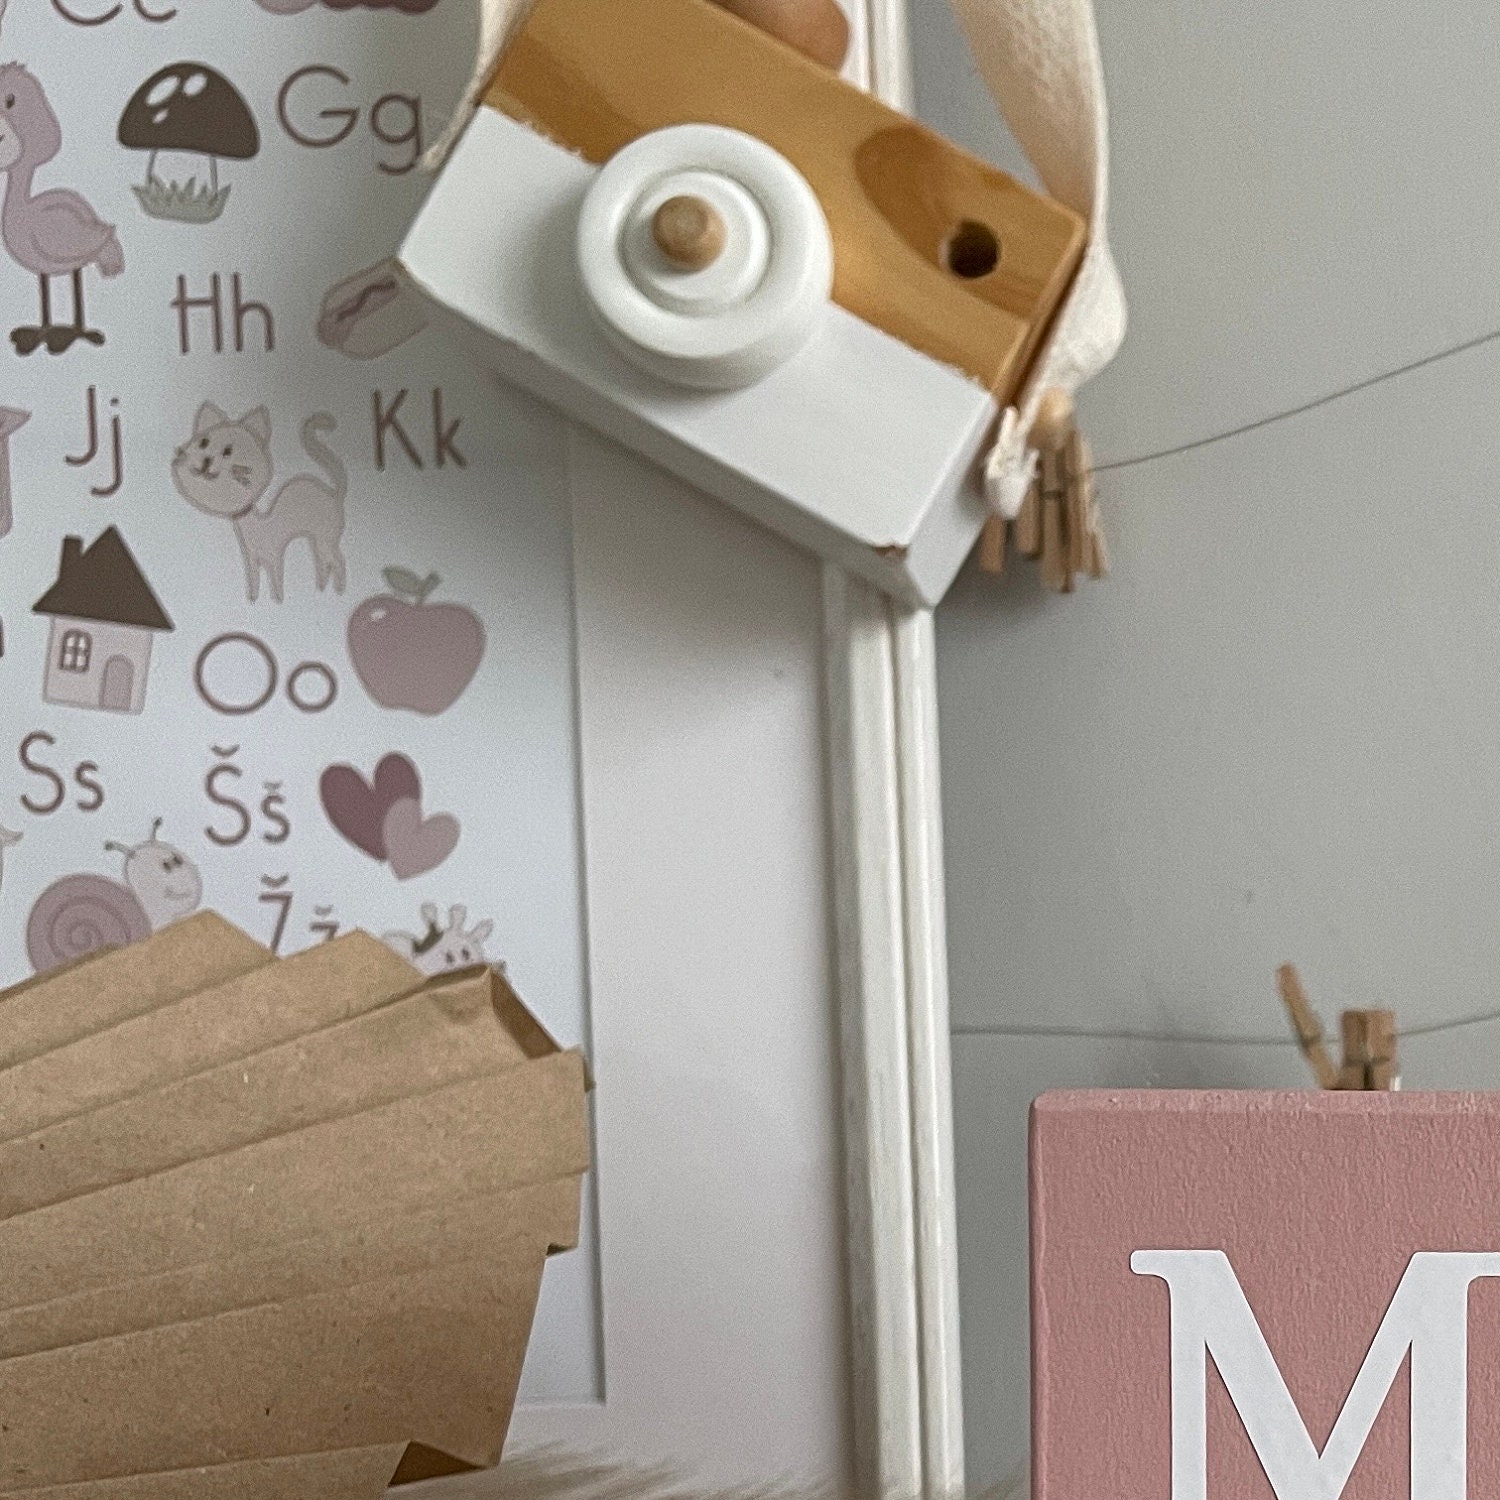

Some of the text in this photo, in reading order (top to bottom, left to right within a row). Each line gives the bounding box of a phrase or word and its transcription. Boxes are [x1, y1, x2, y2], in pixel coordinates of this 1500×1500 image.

[275, 63, 423, 176] Gg
[170, 271, 275, 356] Hh
[63, 384, 124, 499] Jj
[372, 388, 468, 471] Kk
[193, 631, 339, 717] Oo
[18, 729, 105, 816] Ss
[203, 744, 291, 848] Šš
